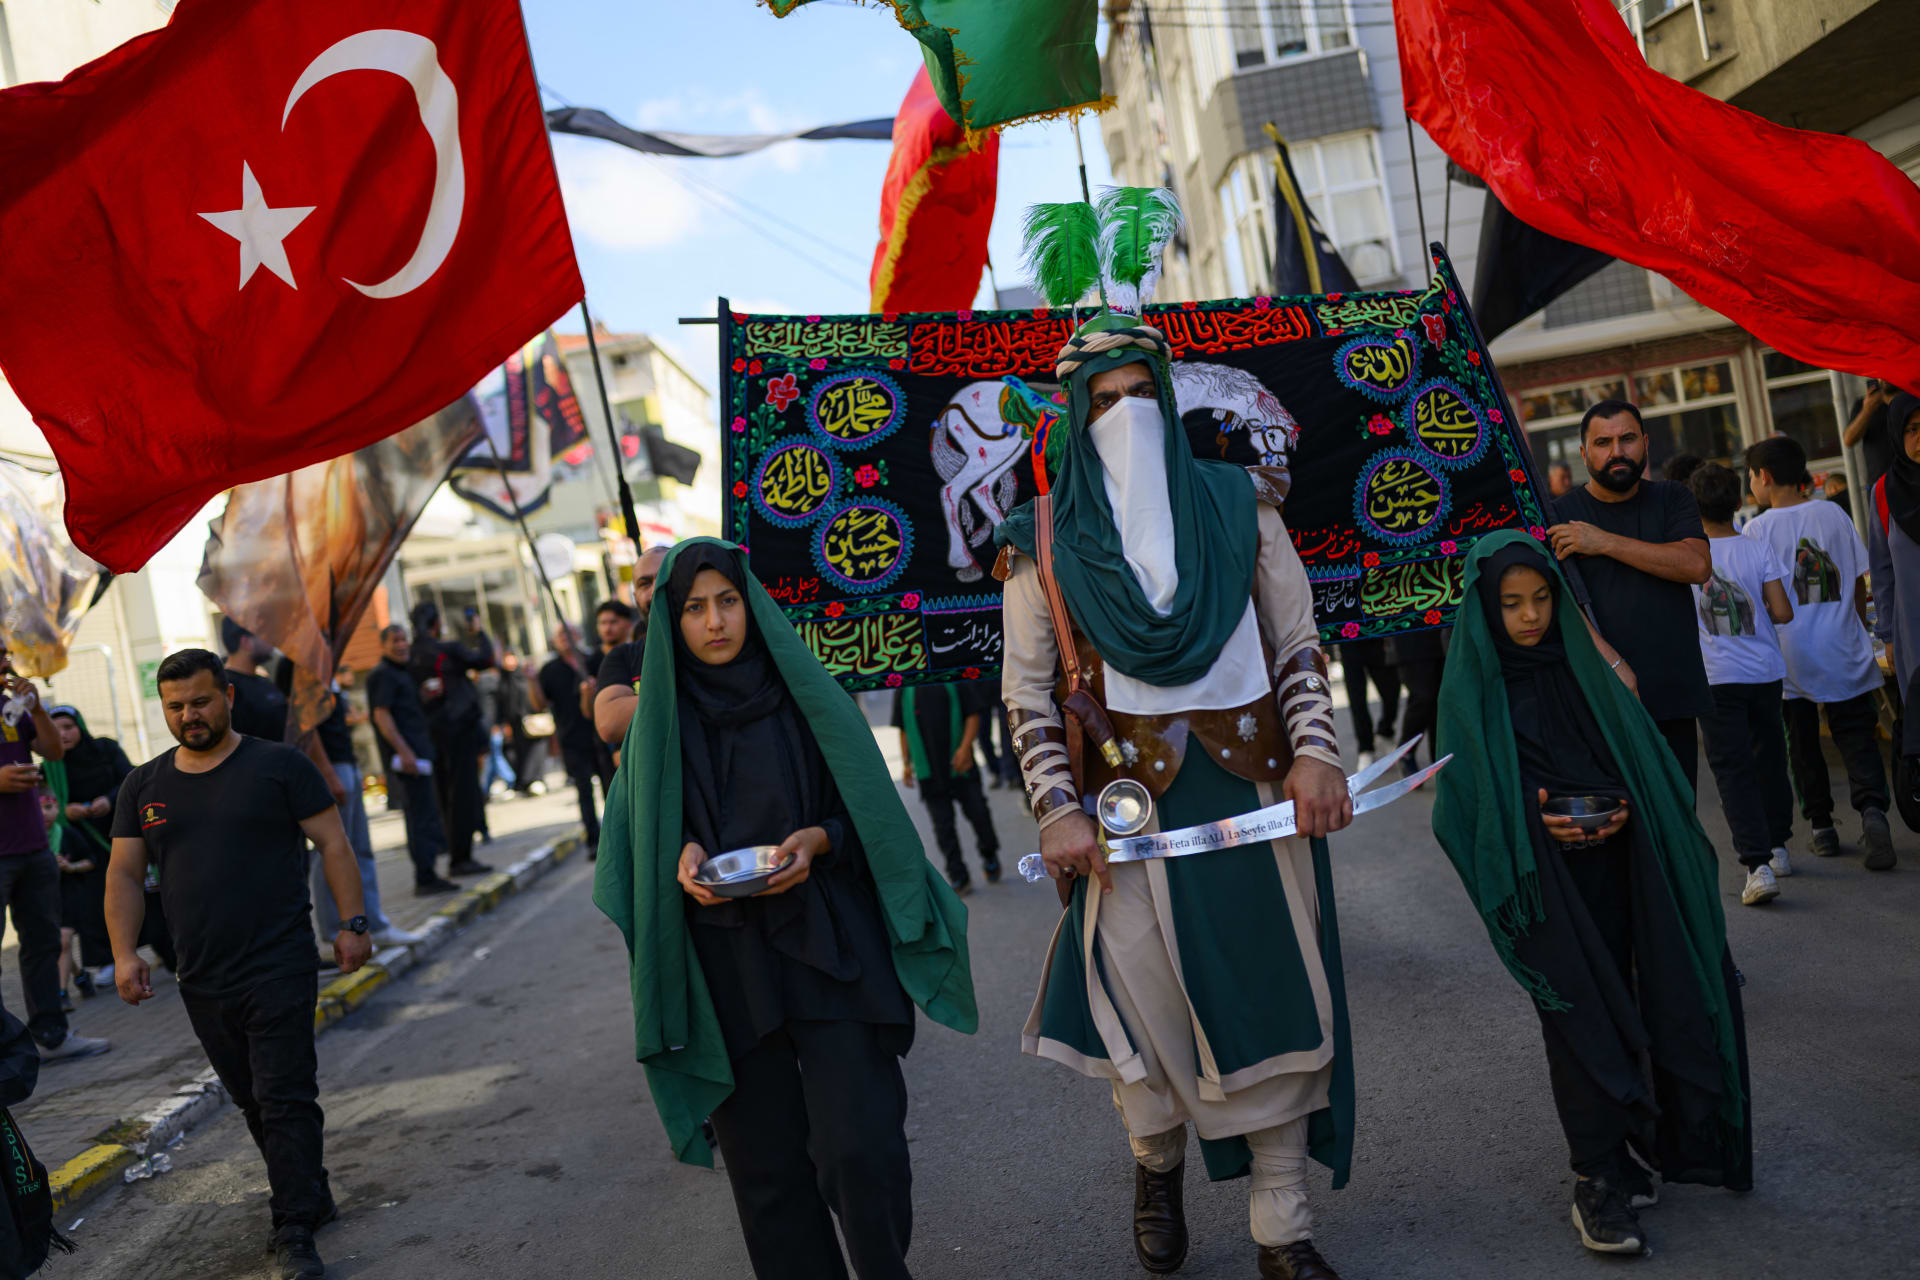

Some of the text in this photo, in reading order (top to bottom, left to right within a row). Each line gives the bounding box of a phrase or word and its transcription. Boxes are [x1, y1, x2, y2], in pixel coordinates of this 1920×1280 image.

[1349, 339, 1411, 382] الله
[824, 387, 892, 433] محمد
[1155, 841, 1168, 851] La
[1169, 838, 1190, 849] Feta
[1191, 835, 1207, 848] illa
[1228, 829, 1241, 840] La
[1241, 822, 1267, 838] Seyfe
[1267, 817, 1283, 831] illa
